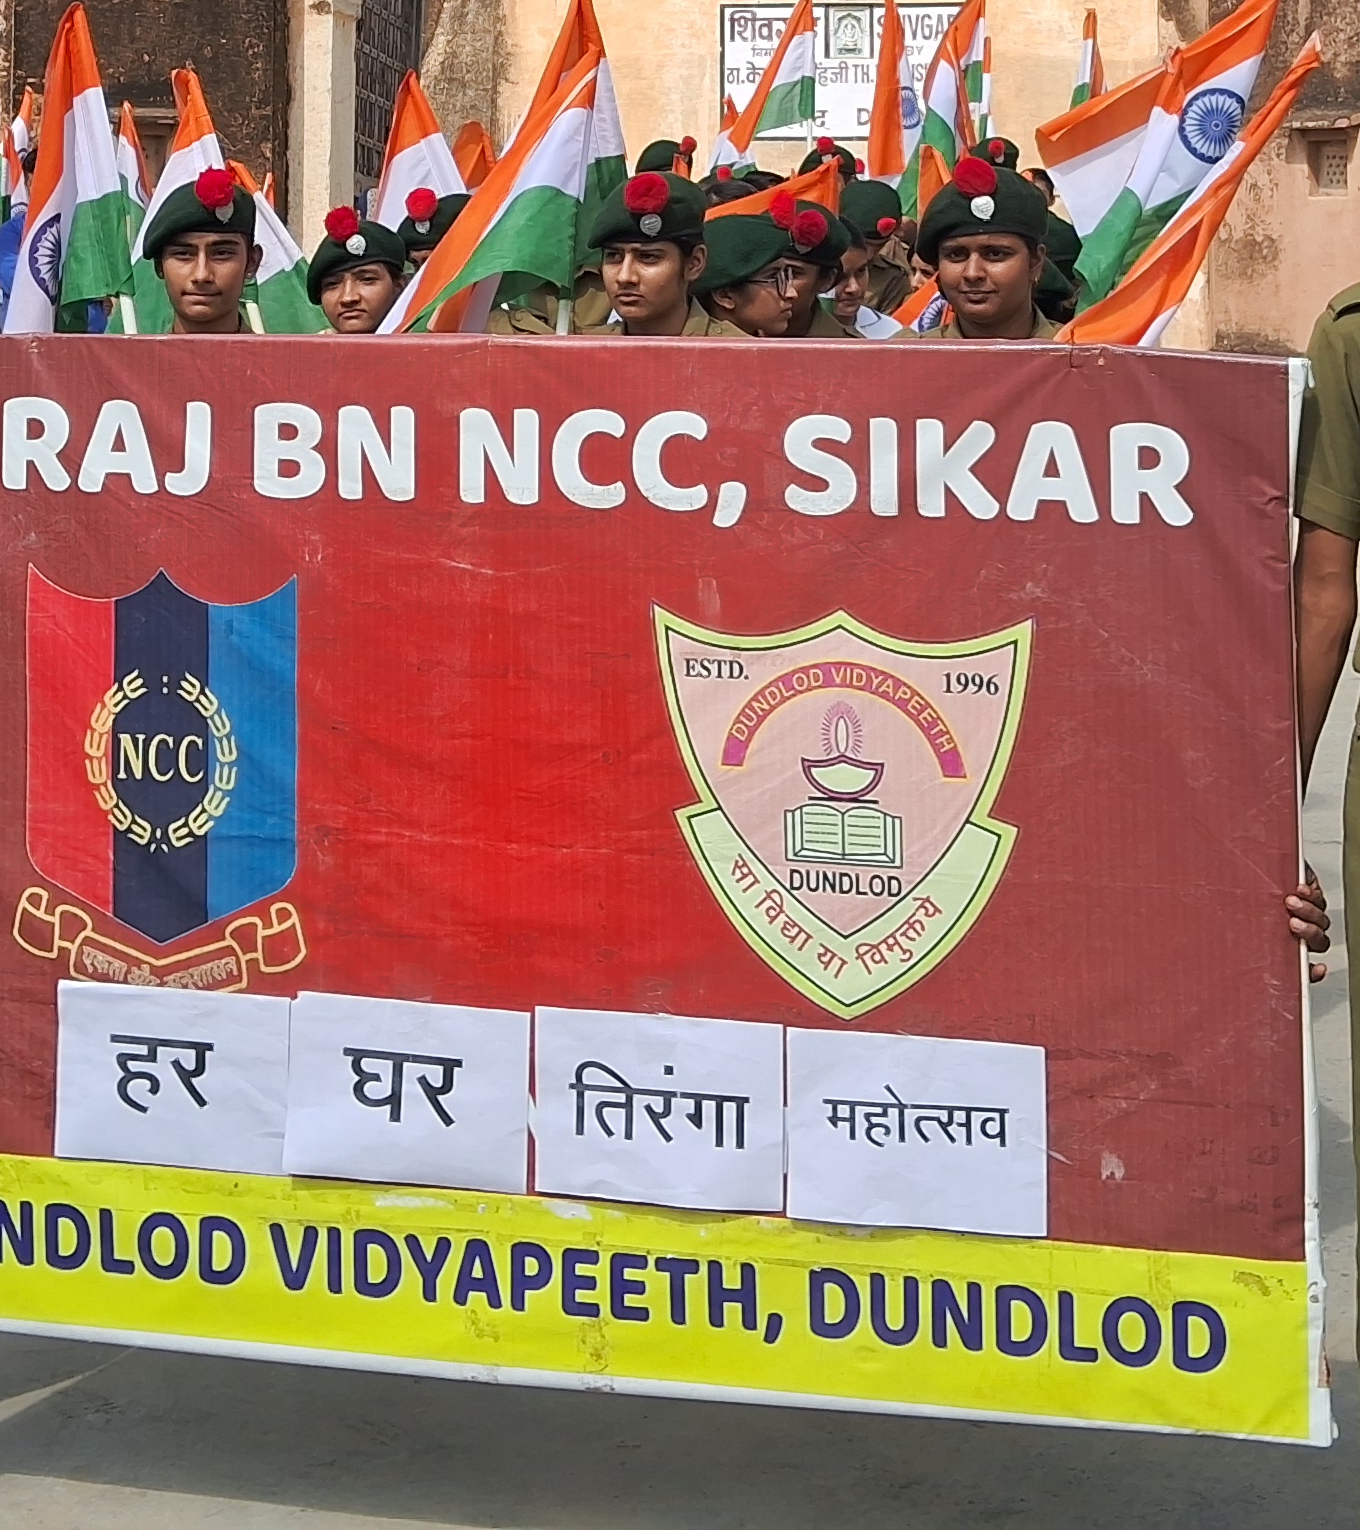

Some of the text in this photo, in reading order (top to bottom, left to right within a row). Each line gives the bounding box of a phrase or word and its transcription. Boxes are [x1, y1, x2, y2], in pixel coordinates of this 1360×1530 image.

[1, 396, 213, 497] RAJ
[253, 402, 417, 501] BN
[458, 407, 747, 529] NCC,
[783, 414, 1195, 528] SIKAR
[684, 658, 750, 682] ESTD.
[941, 671, 1000, 696] 1996
[730, 666, 956, 754] DUNDLOD VIDYAPEETH
[117, 733, 204, 783] NCC
[730, 853, 761, 893] सा
[753, 887, 814, 952] विद्या
[817, 942, 849, 979] या
[788, 869, 903, 897] DUNDLOD
[82, 945, 128, 981] एकता
[110, 1033, 1011, 1149] हर घर तिरंगा महोत्सव
[269, 1222, 784, 1344] VIDYAPEETH,
[808, 1267, 1228, 1374] DUNDLOD
